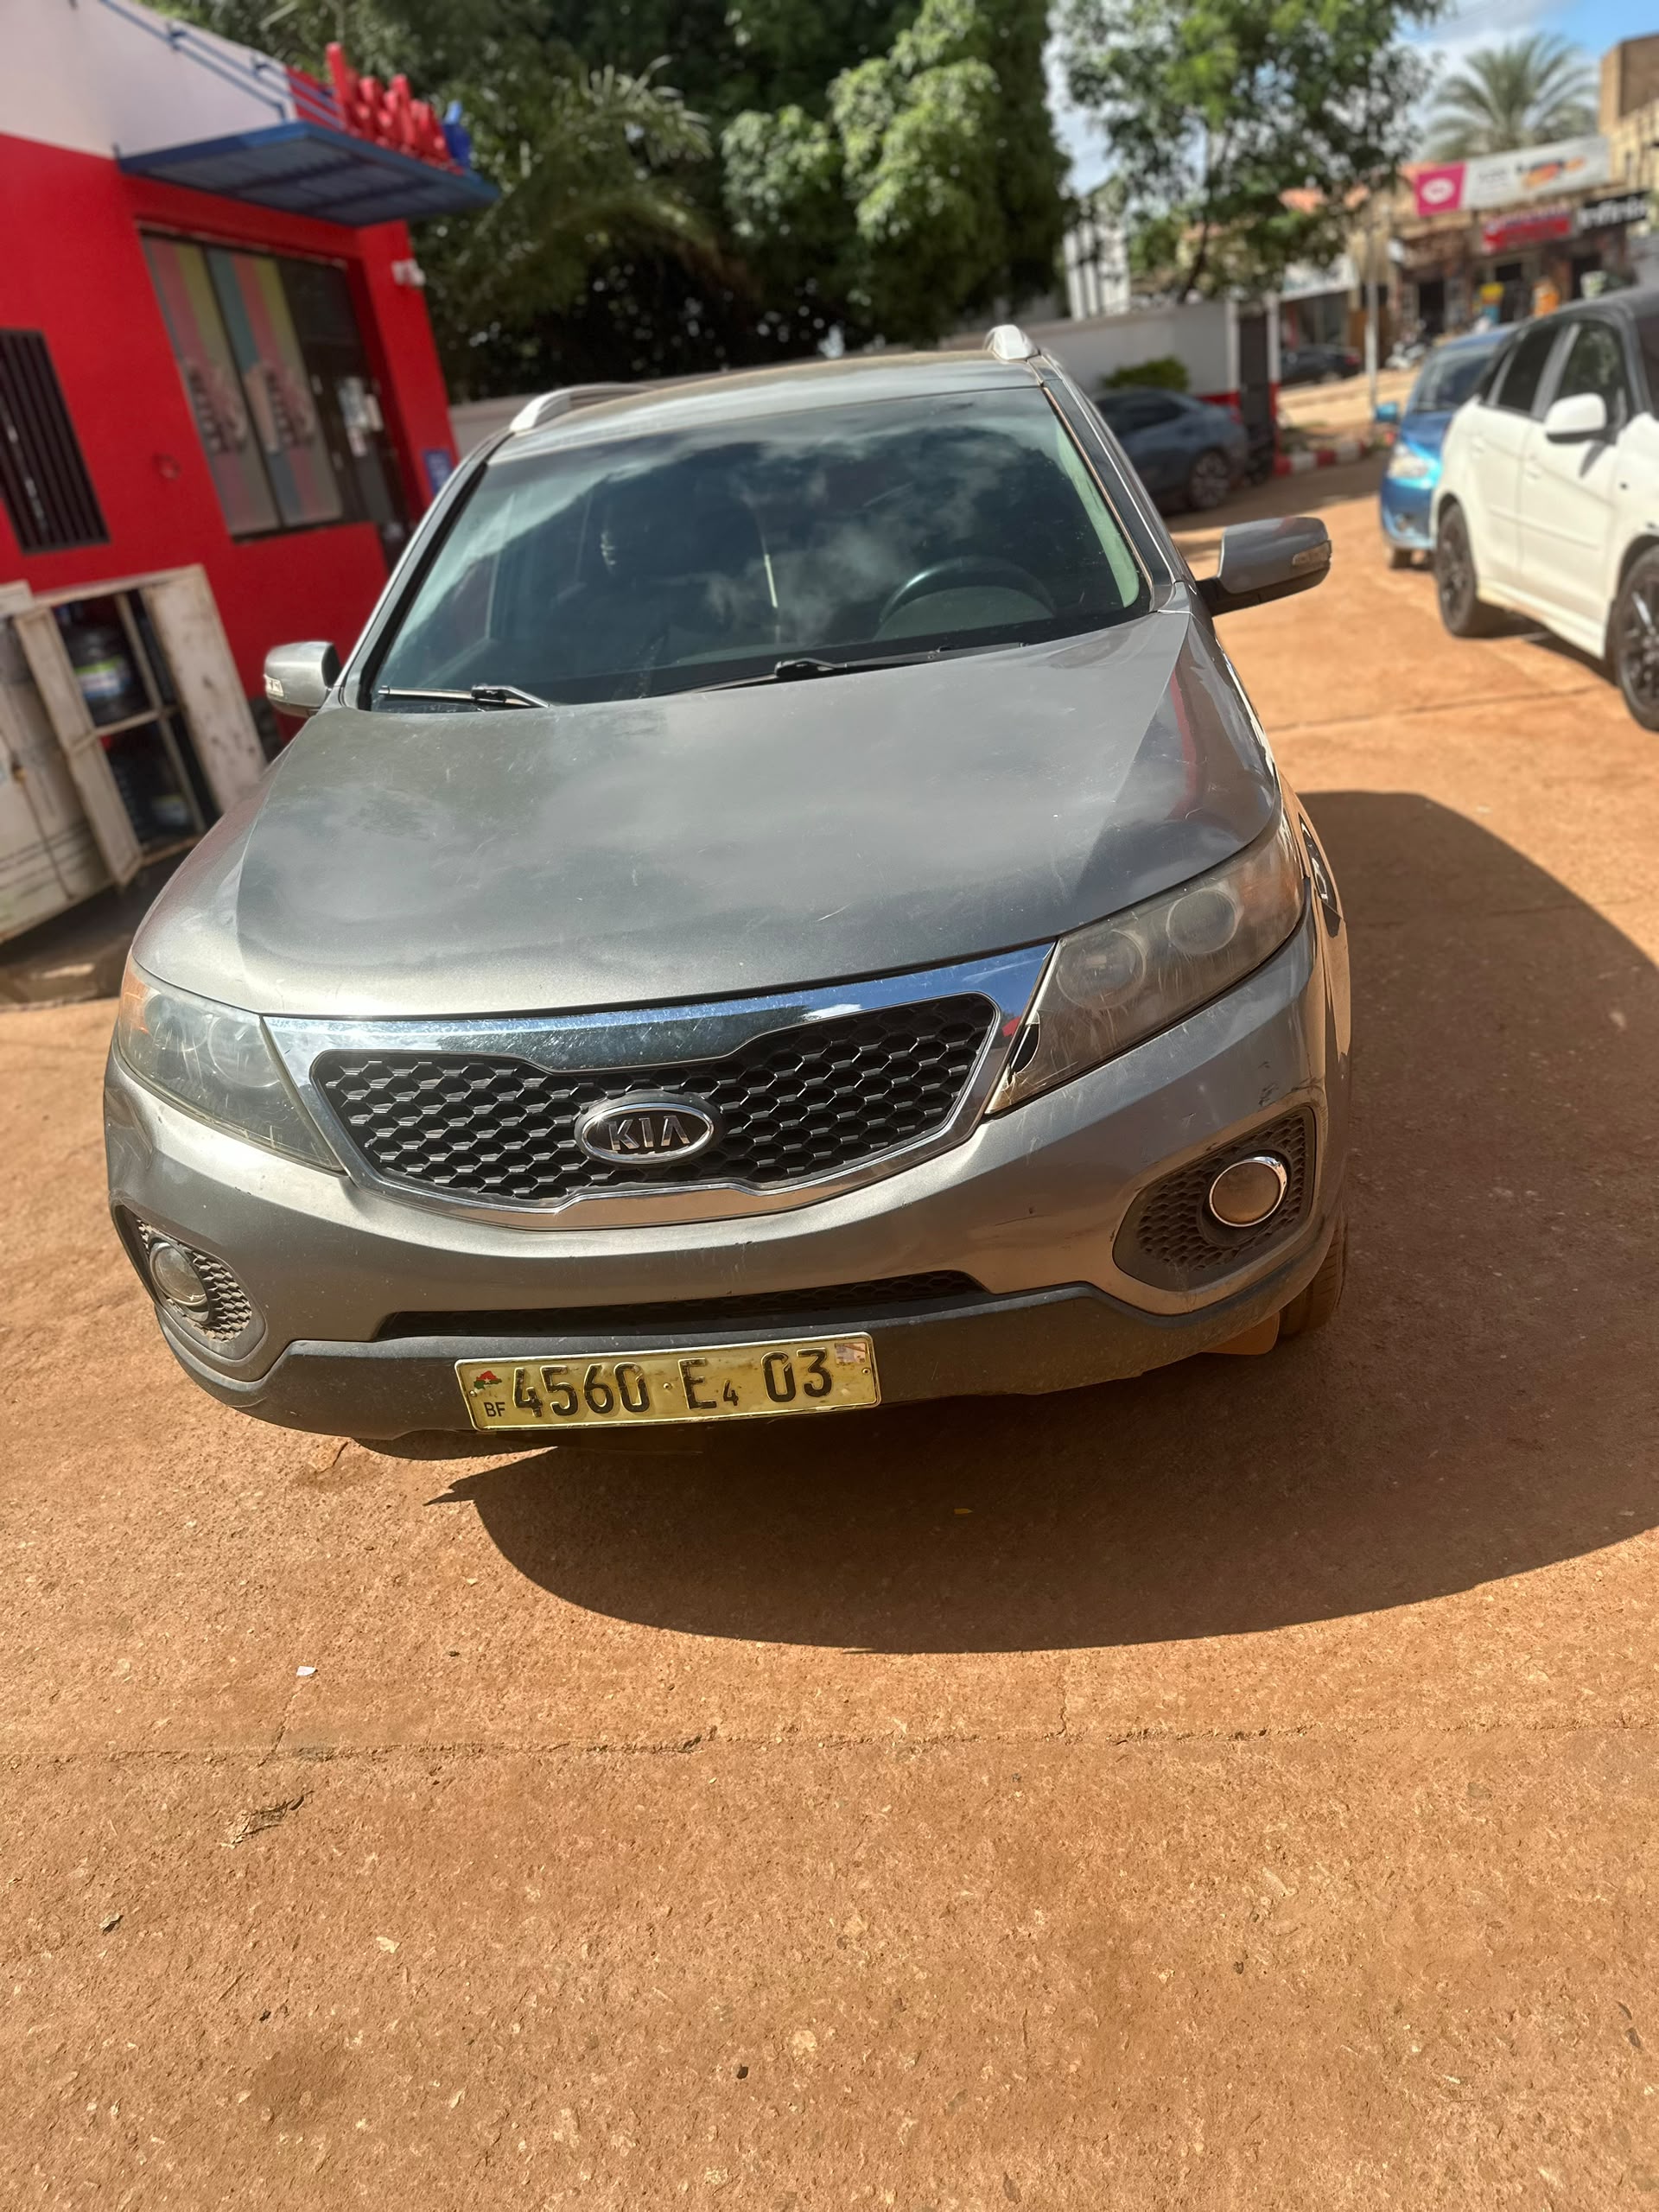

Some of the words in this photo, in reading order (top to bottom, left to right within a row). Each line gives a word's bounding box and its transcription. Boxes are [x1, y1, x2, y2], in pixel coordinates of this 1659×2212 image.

[608, 1115, 690, 1151] KIA
[512, 1362, 650, 1417] 4560
[760, 1347, 832, 1402] 03
[483, 1402, 505, 1417] BF
